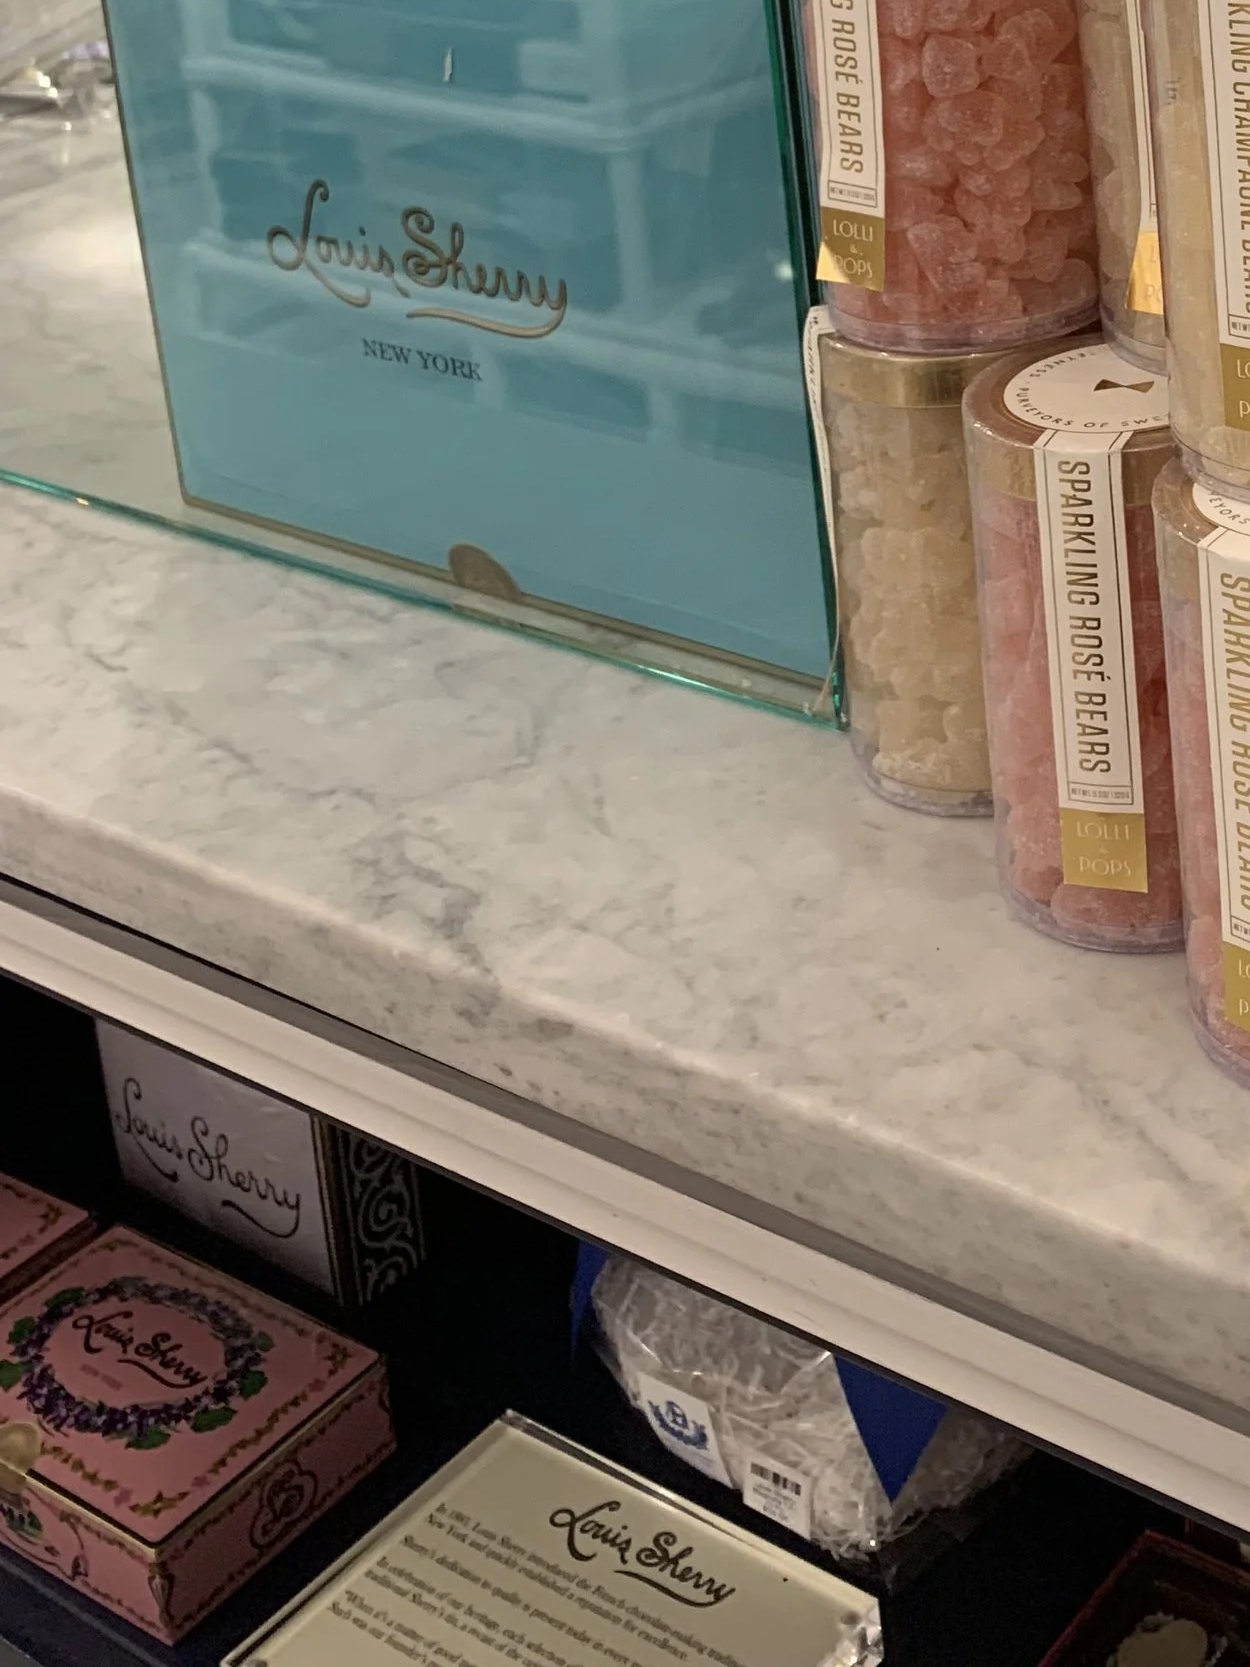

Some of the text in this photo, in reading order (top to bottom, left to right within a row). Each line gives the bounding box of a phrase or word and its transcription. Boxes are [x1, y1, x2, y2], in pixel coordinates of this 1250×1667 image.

[830, 16, 864, 87] ROSÉ
[836, 87, 865, 174] BEARS
[266, 178, 568, 339] Louis Sherry
[832, 218, 873, 243] LOLLI
[361, 338, 483, 382] NEW YORK
[1057, 459, 1100, 606] SPARKLING
[1068, 612, 1112, 686] ROSÉ
[1074, 692, 1112, 774] BEARS
[1076, 820, 1130, 841] LOLLI
[1079, 855, 1132, 878] POPS
[112, 1076, 302, 1240] Louis Sherry
[71, 1310, 135, 1355] Louis
[130, 1332, 209, 1389] Sherry
[549, 1499, 737, 1608] Louis Sherry
